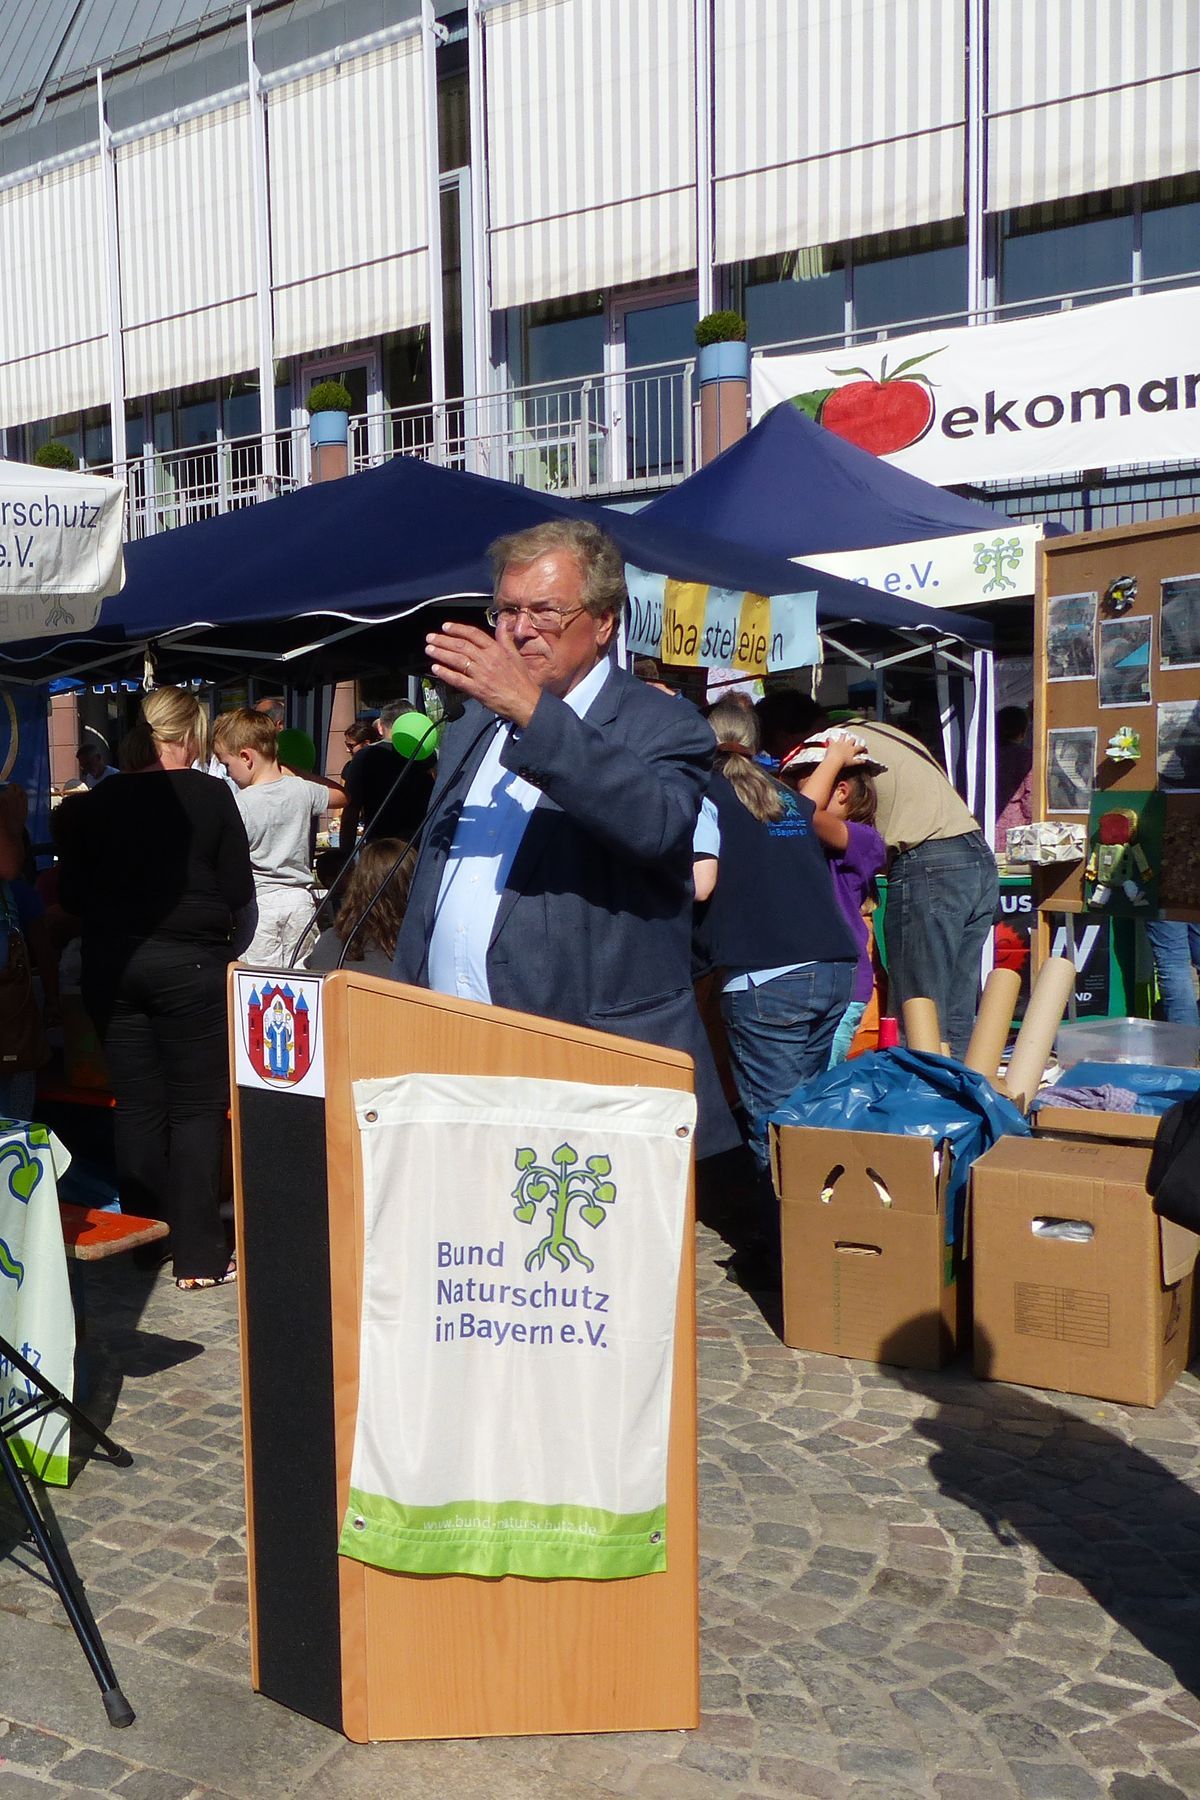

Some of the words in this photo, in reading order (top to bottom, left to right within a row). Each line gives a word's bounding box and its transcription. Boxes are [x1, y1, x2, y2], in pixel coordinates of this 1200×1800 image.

[883, 560, 940, 593] e.V.
[437, 1240, 505, 1268] Bund
[436, 1277, 610, 1313] Naturschutz
[435, 1315, 455, 1343] in
[459, 1312, 554, 1346] Bayern
[560, 1320, 608, 1349] e.V.
